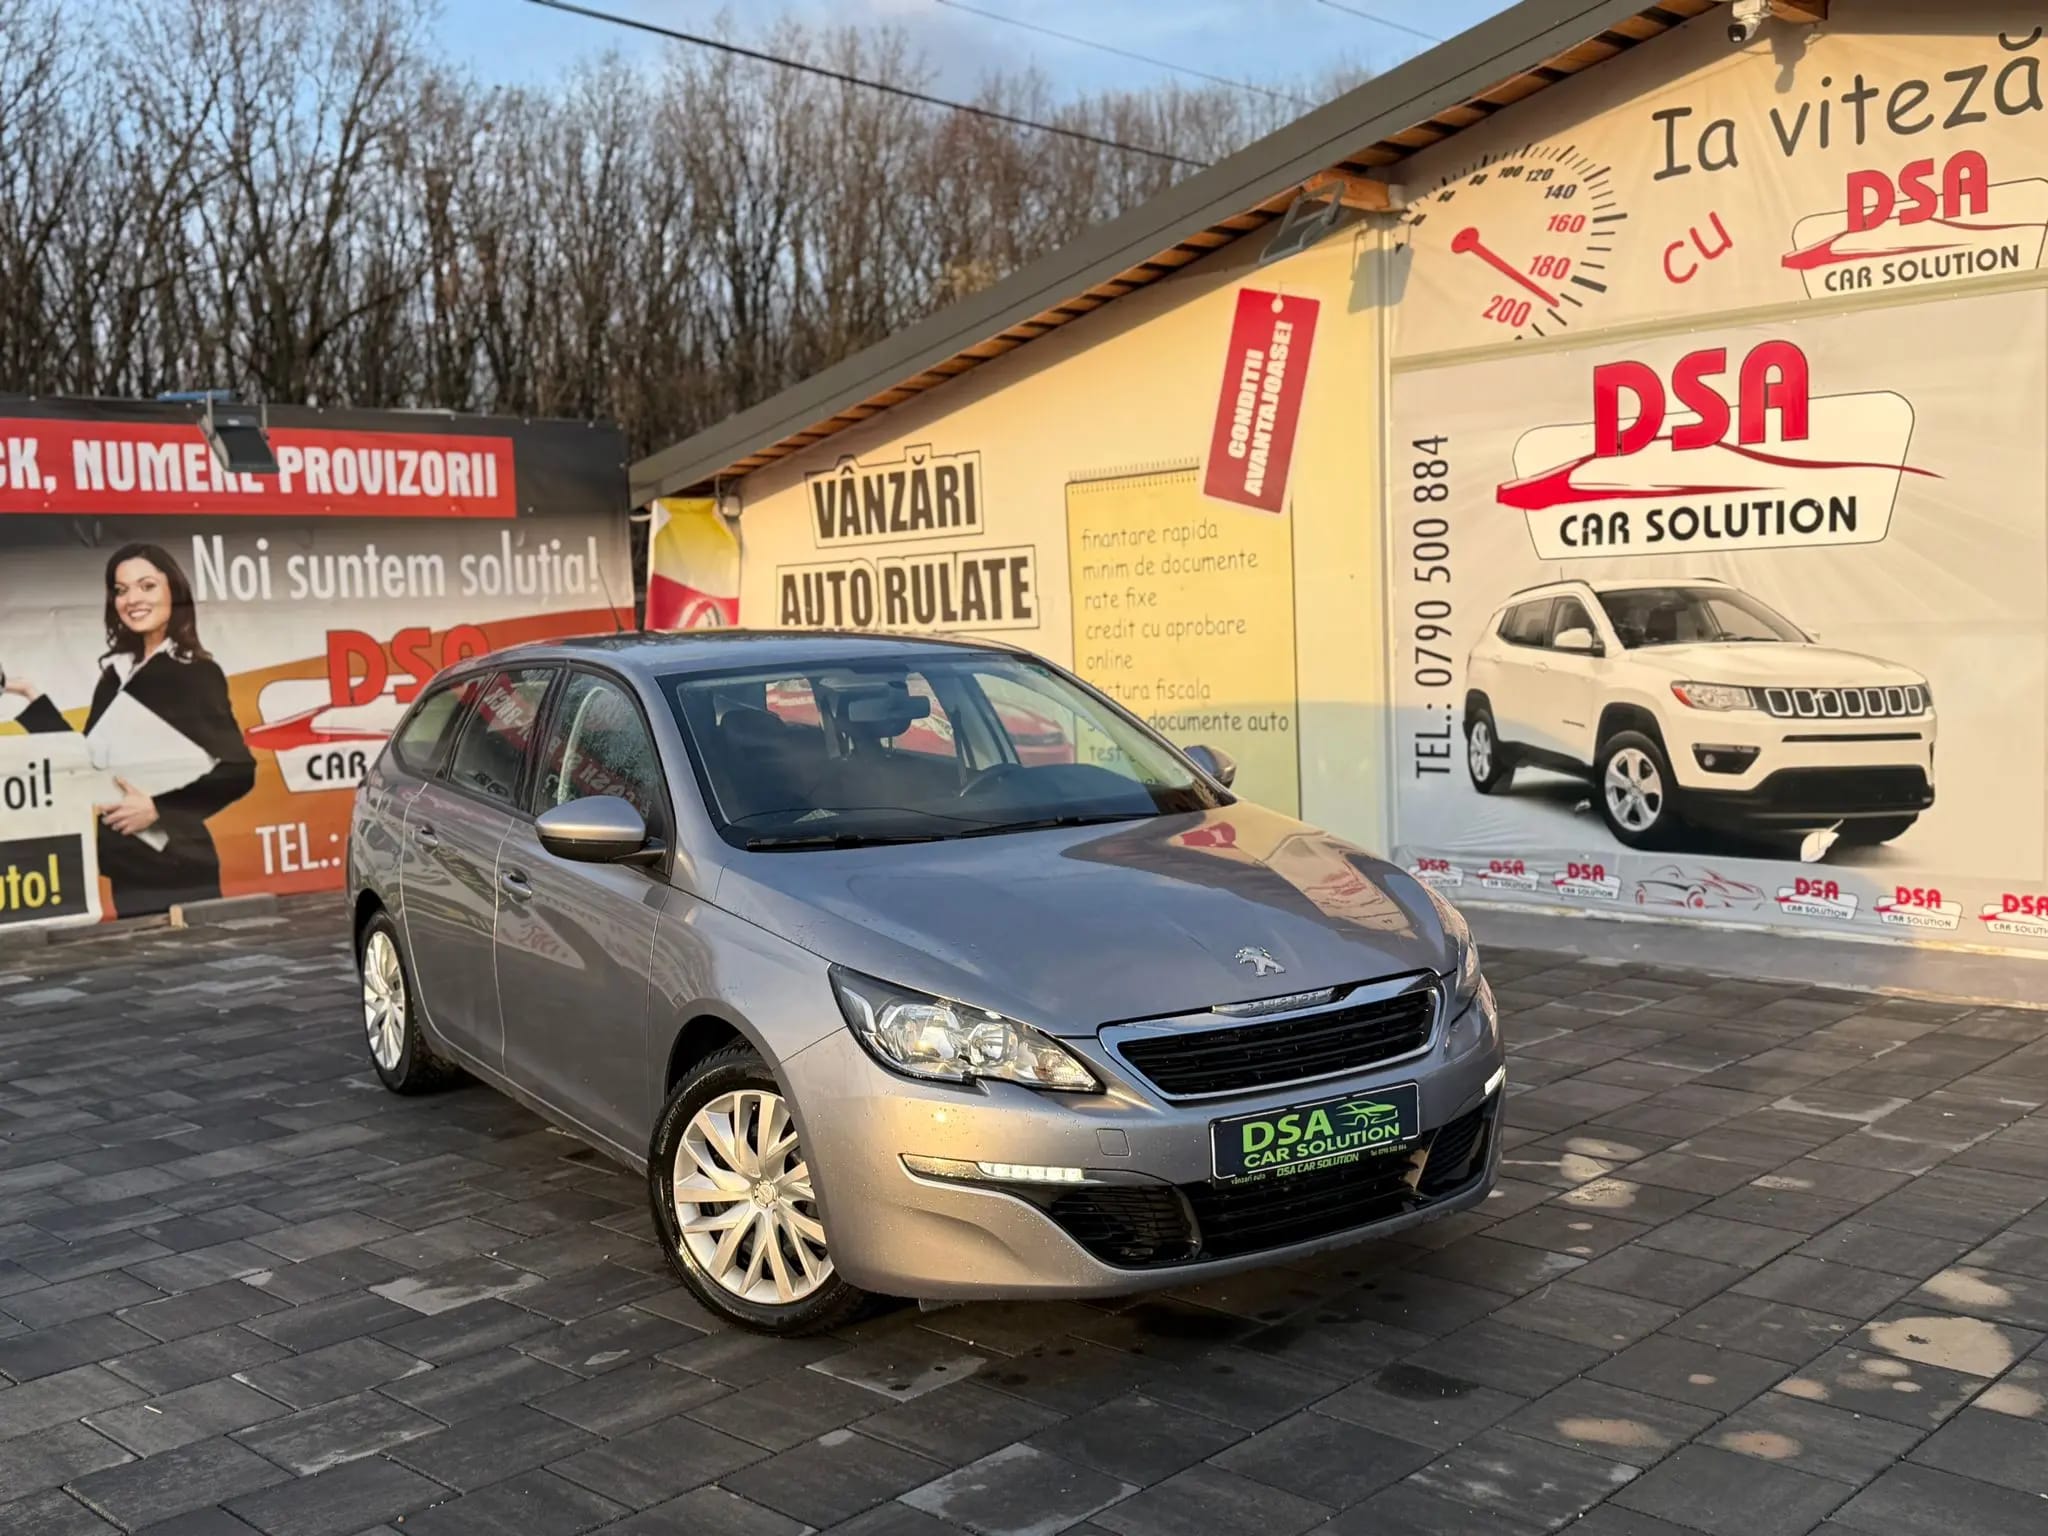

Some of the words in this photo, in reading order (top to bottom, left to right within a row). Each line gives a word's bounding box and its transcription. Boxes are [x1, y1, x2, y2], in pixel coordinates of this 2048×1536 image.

[1651, 106, 1739, 181] Ia
[1769, 26, 2044, 160] viteză
[1525, 167, 1554, 182] 120
[1544, 184, 1577, 199] 140
[1846, 150, 1989, 234] DSA
[1546, 213, 1586, 233] 160
[1662, 211, 1733, 284] cu
[1528, 255, 1571, 280] 180
[1824, 267, 1873, 293] CAR
[1882, 245, 2020, 286] SOLUTION
[1482, 295, 1531, 328] 200
[1592, 340, 1810, 459] DSA
[277, 445, 499, 499] PROVIZORII
[1412, 435, 1449, 502] 884
[813, 454, 977, 539] VÂNZĂRI
[1081, 528, 1158, 551] finantare
[1161, 518, 1219, 549] rapida
[1559, 508, 1630, 548] CAR
[1645, 495, 1858, 544] SOLUTION
[1082, 557, 1130, 580] minim
[1134, 556, 1156, 578] de
[1161, 549, 1260, 576] documente
[1413, 518, 1451, 583] 500
[192, 534, 273, 602] Noi
[286, 543, 446, 600] suntem
[781, 567, 873, 627] AUTO
[883, 556, 1033, 625] RULATE
[1084, 592, 1120, 611] rate
[1125, 587, 1158, 611] fixe
[1085, 617, 1136, 641] credit
[1141, 623, 1160, 639] cu
[1165, 613, 1247, 643] aprobare
[1415, 600, 1452, 687] 0790
[1086, 650, 1133, 670] online
[1155, 676, 1212, 701] fiscala
[1247, 711, 1290, 732] auto
[306, 750, 368, 783] CAR
[1489, 859, 1526, 876] DSA
[1567, 862, 1605, 882] DSA
[1794, 877, 1840, 901] DSA
[1895, 885, 1942, 909] DSA
[2002, 892, 2048, 916] DSA
[1805, 905, 1848, 919] SOLUTION
[1906, 915, 1952, 928] SOLUTION
[1242, 1108, 1335, 1153] DSA
[1243, 1146, 1291, 1168] CAR
[1296, 1122, 1400, 1158] SOLUTION
[1276, 1165, 1297, 1177] DSA
[1297, 1160, 1317, 1174] CAR
[1317, 1152, 1360, 1170] SOLUTION
